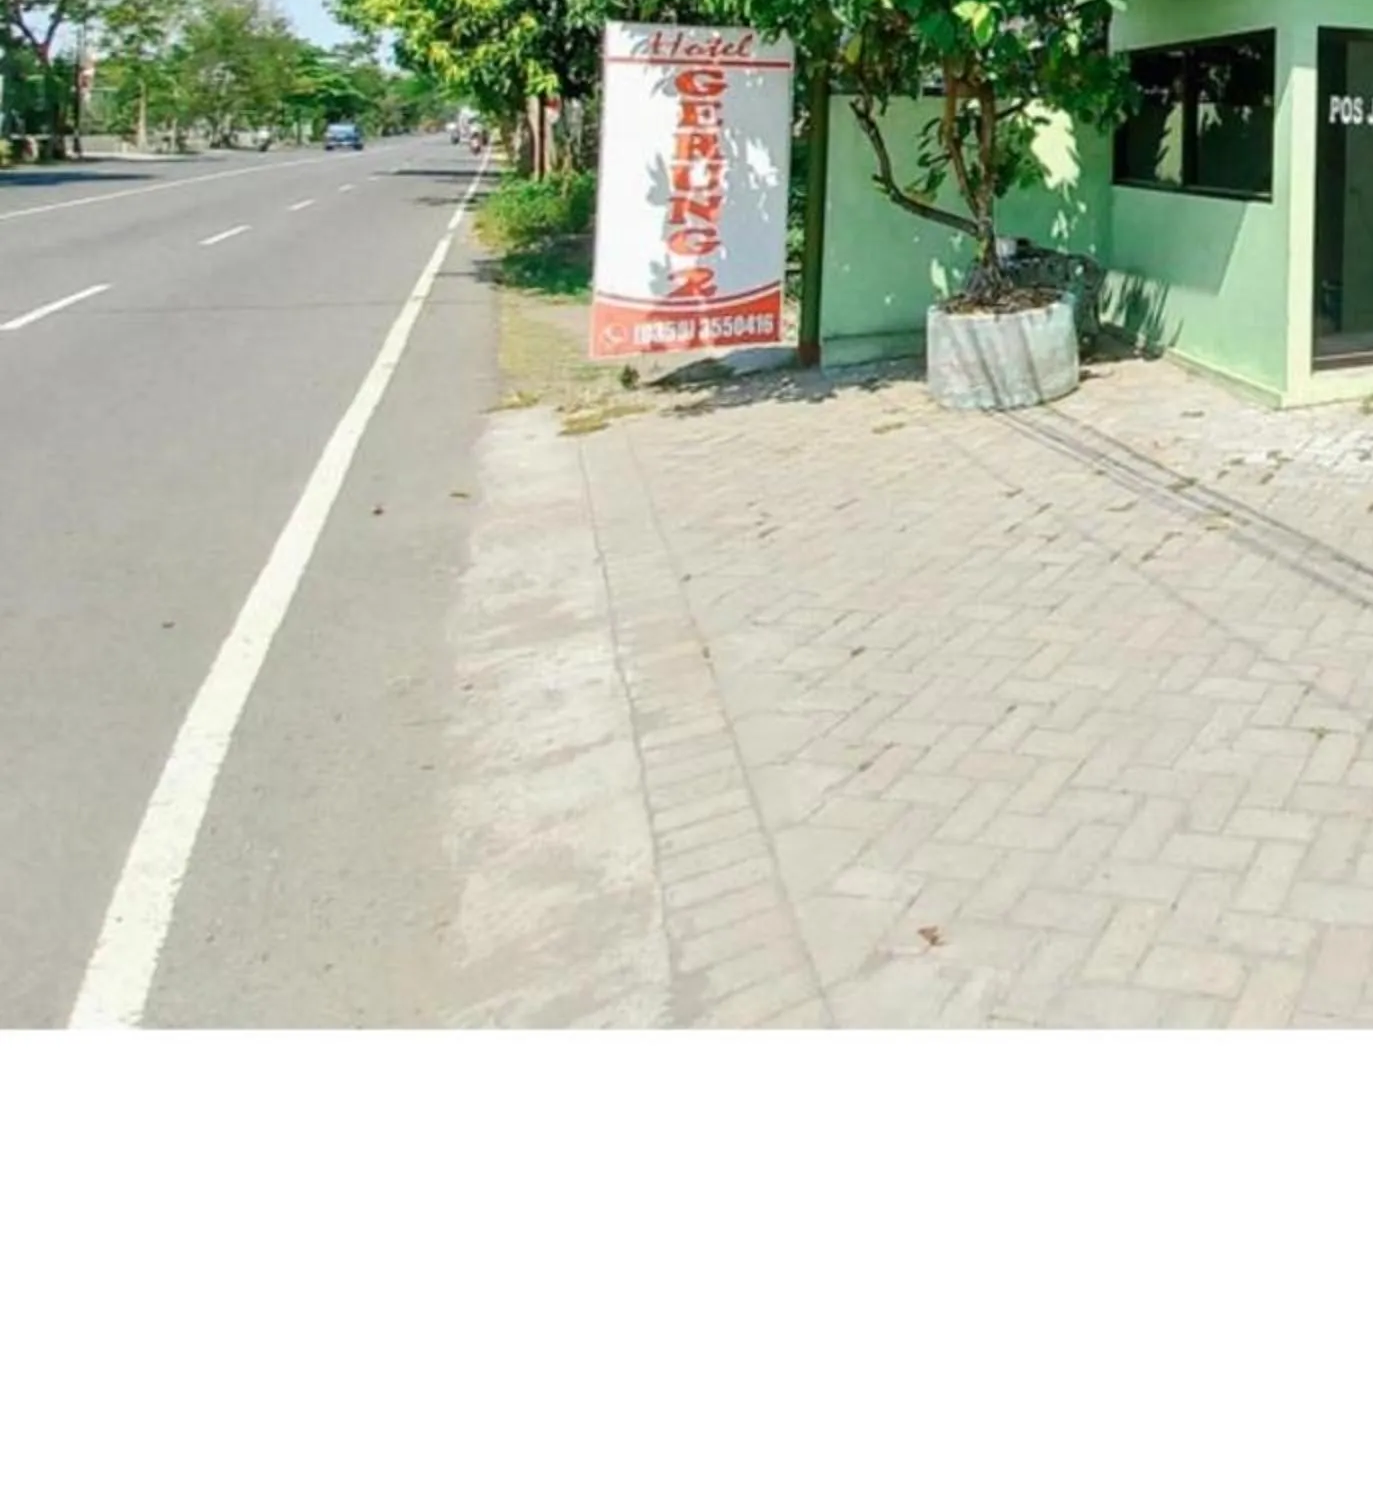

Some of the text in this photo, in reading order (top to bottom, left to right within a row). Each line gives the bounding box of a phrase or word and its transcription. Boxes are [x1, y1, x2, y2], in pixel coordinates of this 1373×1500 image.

[646, 29, 753, 58] Hotel
[1329, 95, 1363, 124] POS
[667, 69, 728, 298] GERUNG 2
